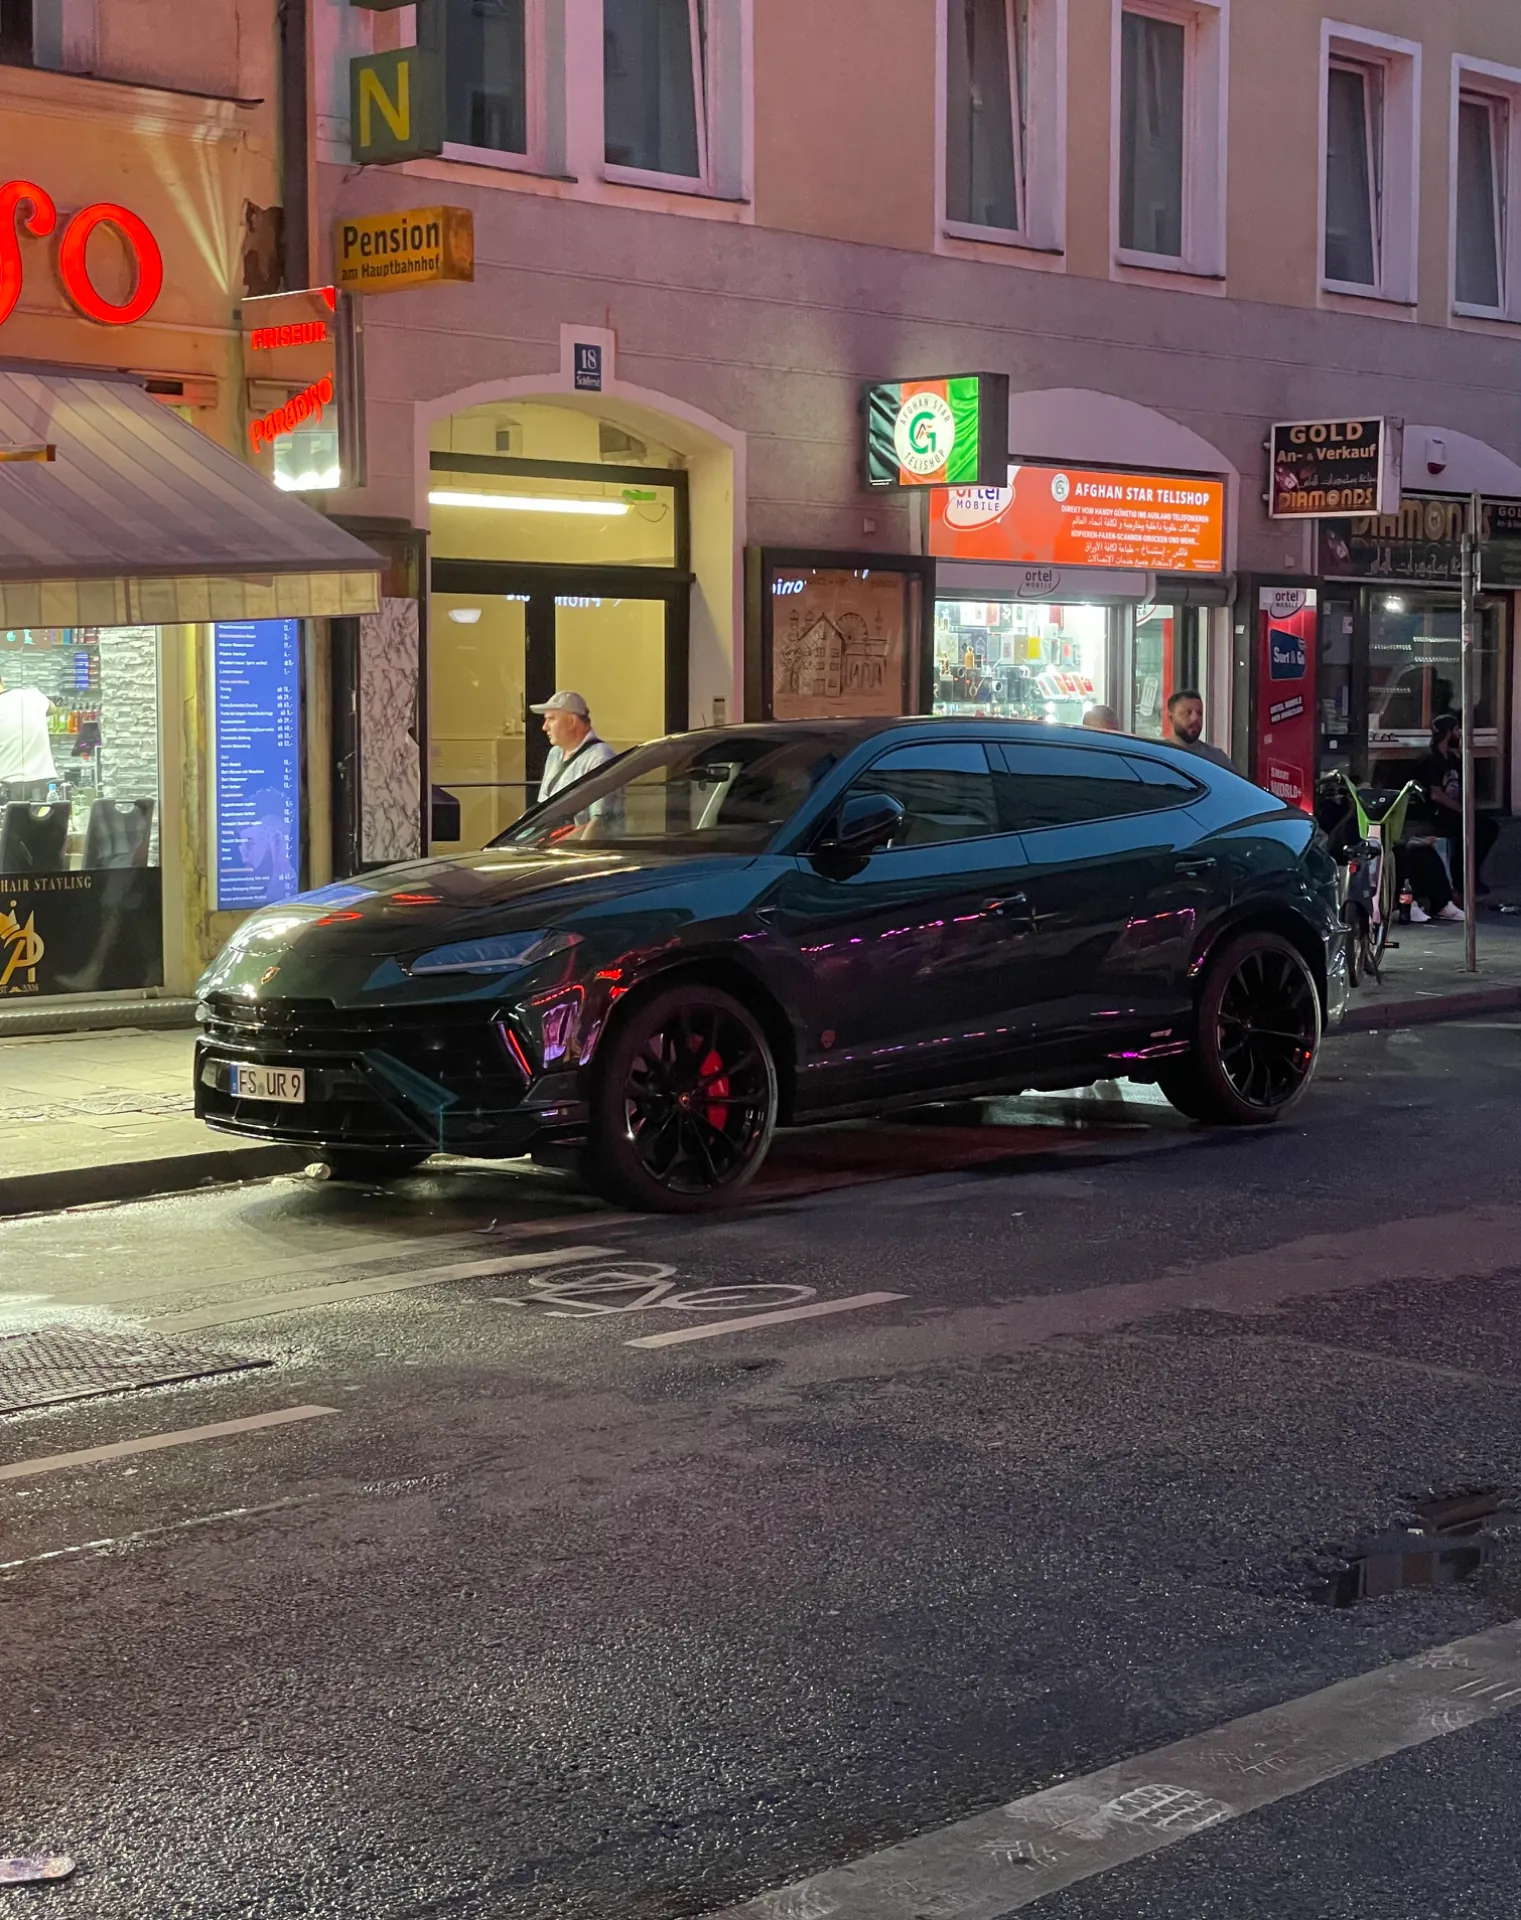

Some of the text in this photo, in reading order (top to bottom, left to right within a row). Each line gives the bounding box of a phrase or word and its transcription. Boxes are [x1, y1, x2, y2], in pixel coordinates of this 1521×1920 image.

[359, 61, 410, 148] N
[343, 218, 440, 259] Pension
[342, 253, 440, 281] am Hauptbahnhof
[252, 321, 326, 350] FRISEUR
[582, 349, 597, 369] 18
[900, 398, 950, 425] AFGHAN STAR
[1290, 422, 1363, 443] GOLD
[904, 449, 945, 470] TELISHOP
[1276, 449, 1303, 463] An-
[1316, 443, 1376, 460] Verkauf
[1075, 482, 1210, 506] AFGHAN STAR TELISHOP
[1279, 488, 1373, 507] DIAMONDS
[957, 500, 1000, 512] MOBILE
[1025, 569, 1052, 582] ortel
[1275, 590, 1299, 602] ortel
[1273, 646, 1290, 664] Surf
[1, 876, 92, 892] HAIR STAYLING
[240, 1070, 301, 1098] FS UR 9
